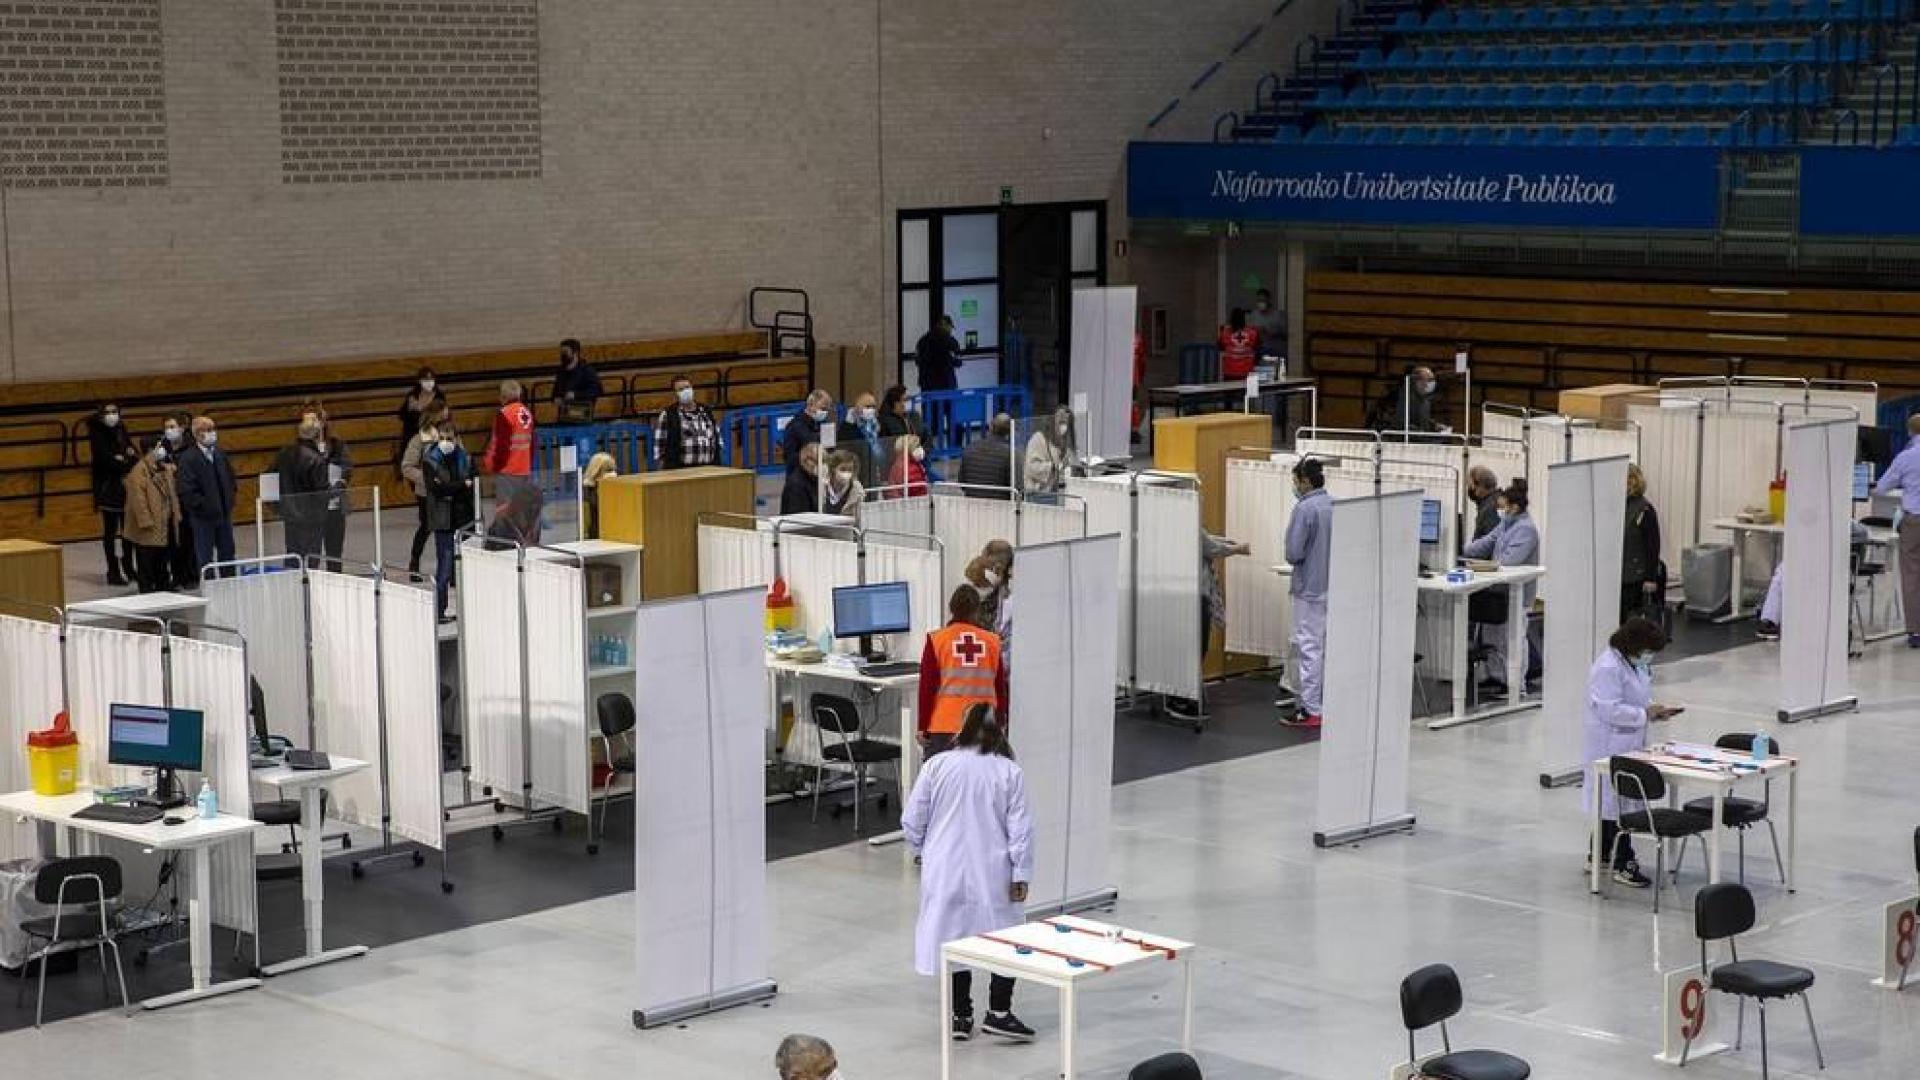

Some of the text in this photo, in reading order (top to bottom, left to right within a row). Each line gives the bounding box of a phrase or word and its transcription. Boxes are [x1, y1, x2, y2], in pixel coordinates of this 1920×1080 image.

[1211, 170, 1616, 204] Nafarroako Unibertsitate Publikoa
[1896, 910, 1915, 966] 8
[1680, 979, 1705, 1040] 9
